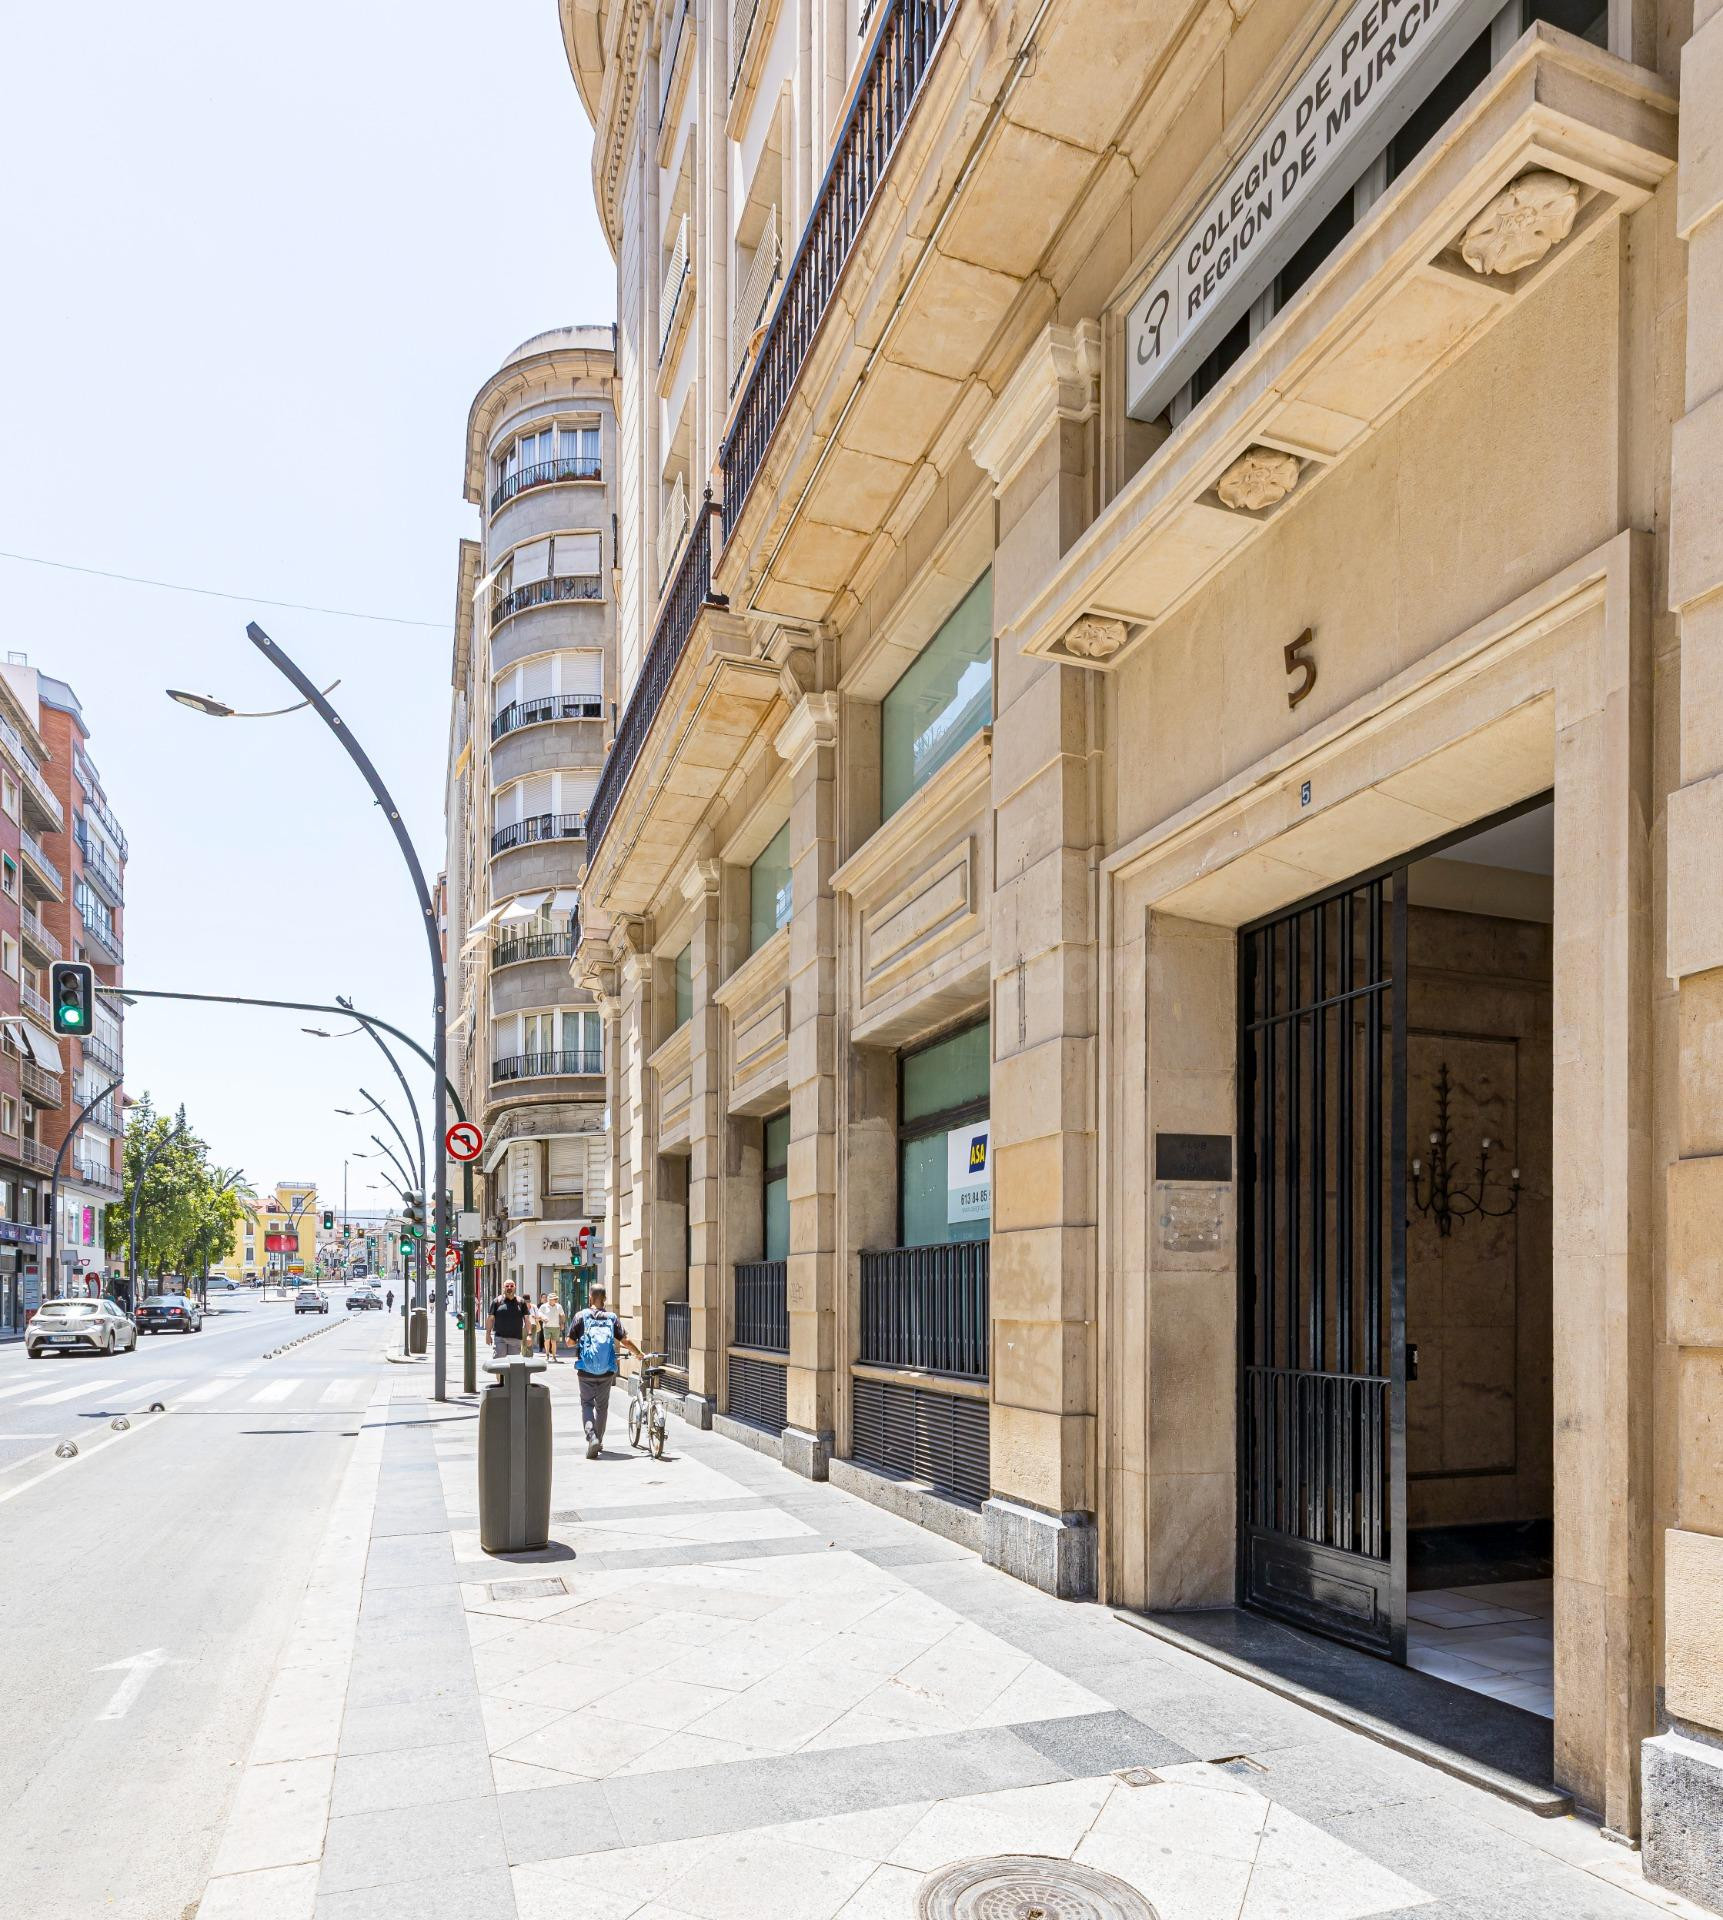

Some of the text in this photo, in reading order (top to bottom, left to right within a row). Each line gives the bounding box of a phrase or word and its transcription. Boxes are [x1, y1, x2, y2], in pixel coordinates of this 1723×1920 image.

[1187, 0, 1441, 321] REGIÓN DE MURCI
[1187, 130, 1287, 276] COLEGIO
[1296, 64, 1332, 138] DE
[1284, 627, 1317, 709] 5
[1302, 783, 1310, 805] 5
[970, 1143, 985, 1165] ASA
